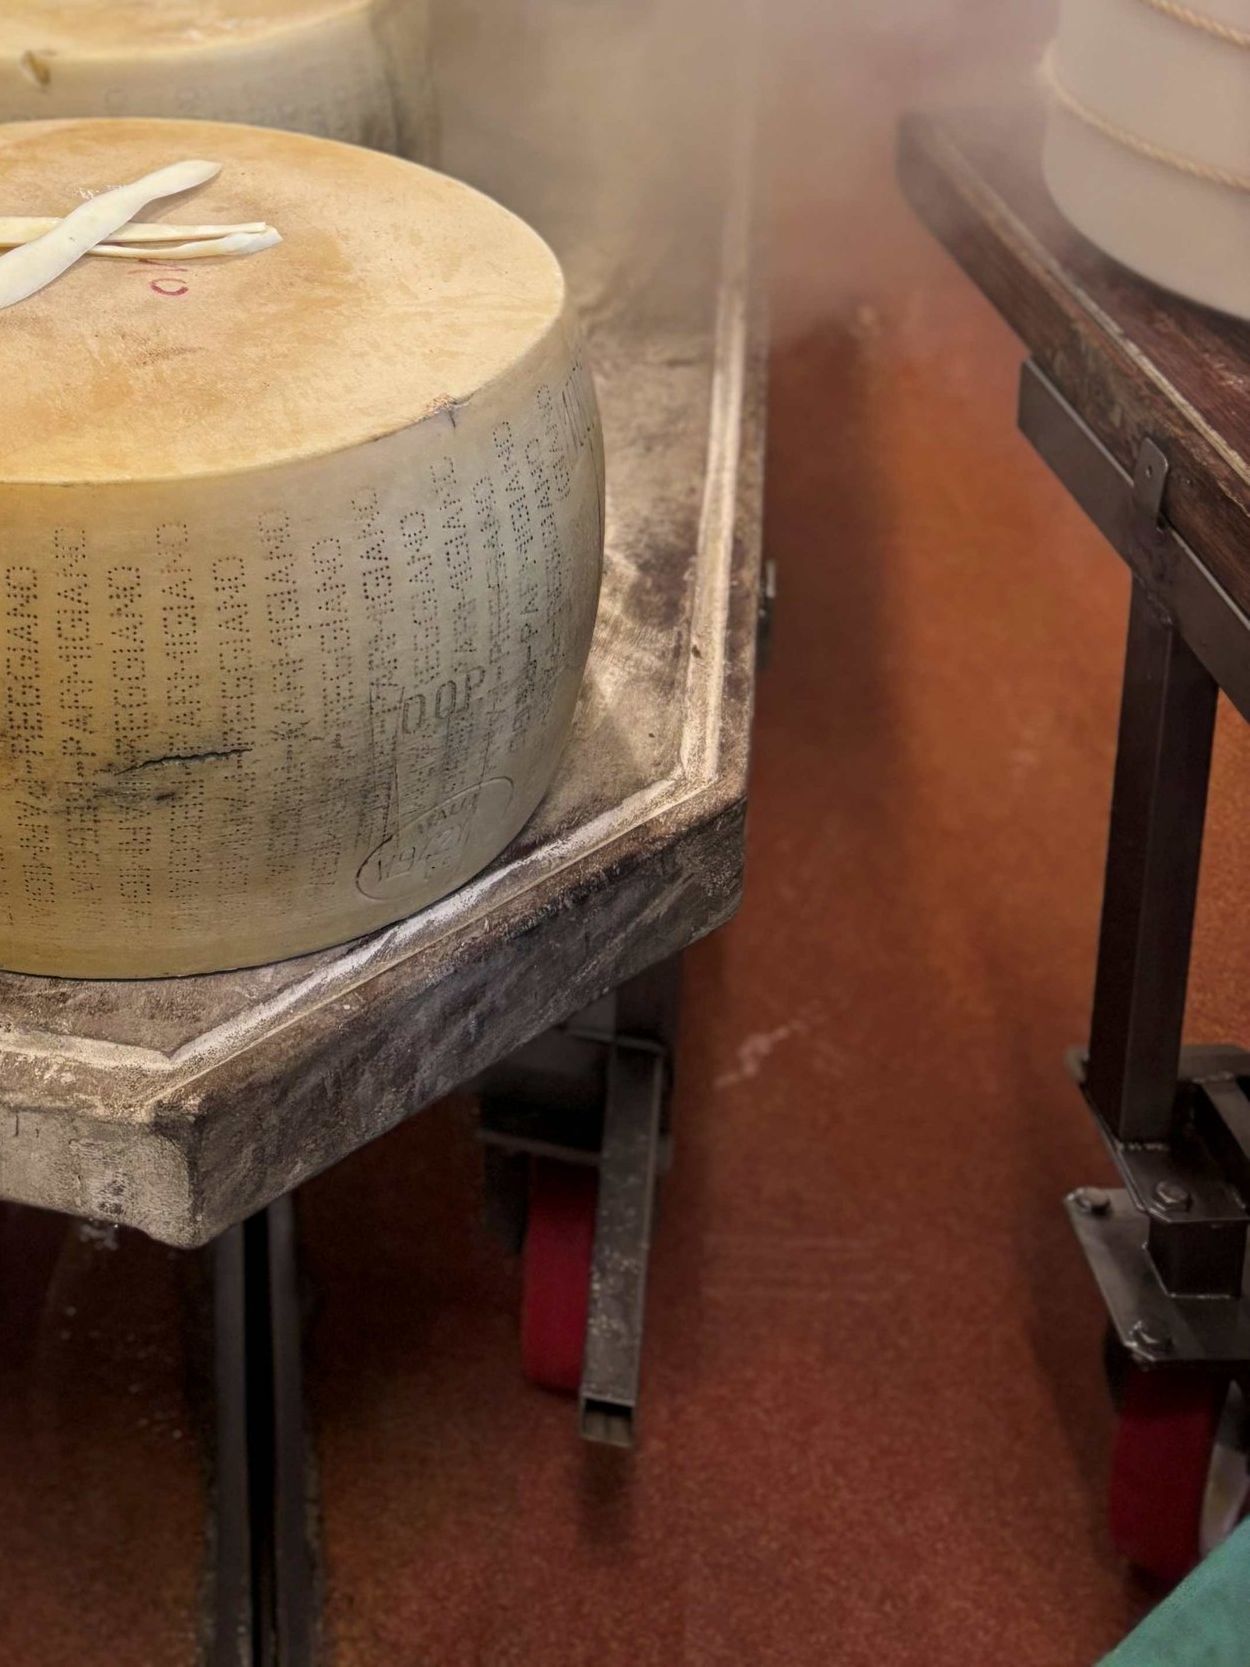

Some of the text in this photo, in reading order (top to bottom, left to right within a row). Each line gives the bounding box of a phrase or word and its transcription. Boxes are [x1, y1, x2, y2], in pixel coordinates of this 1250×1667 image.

[5, 566, 43, 756] REGGIANO
[54, 528, 96, 757] PARMIGIANO
[107, 566, 149, 756] REGGIANO
[156, 522, 201, 753] PARMIGIANO
[211, 556, 256, 747] REGGIANO
